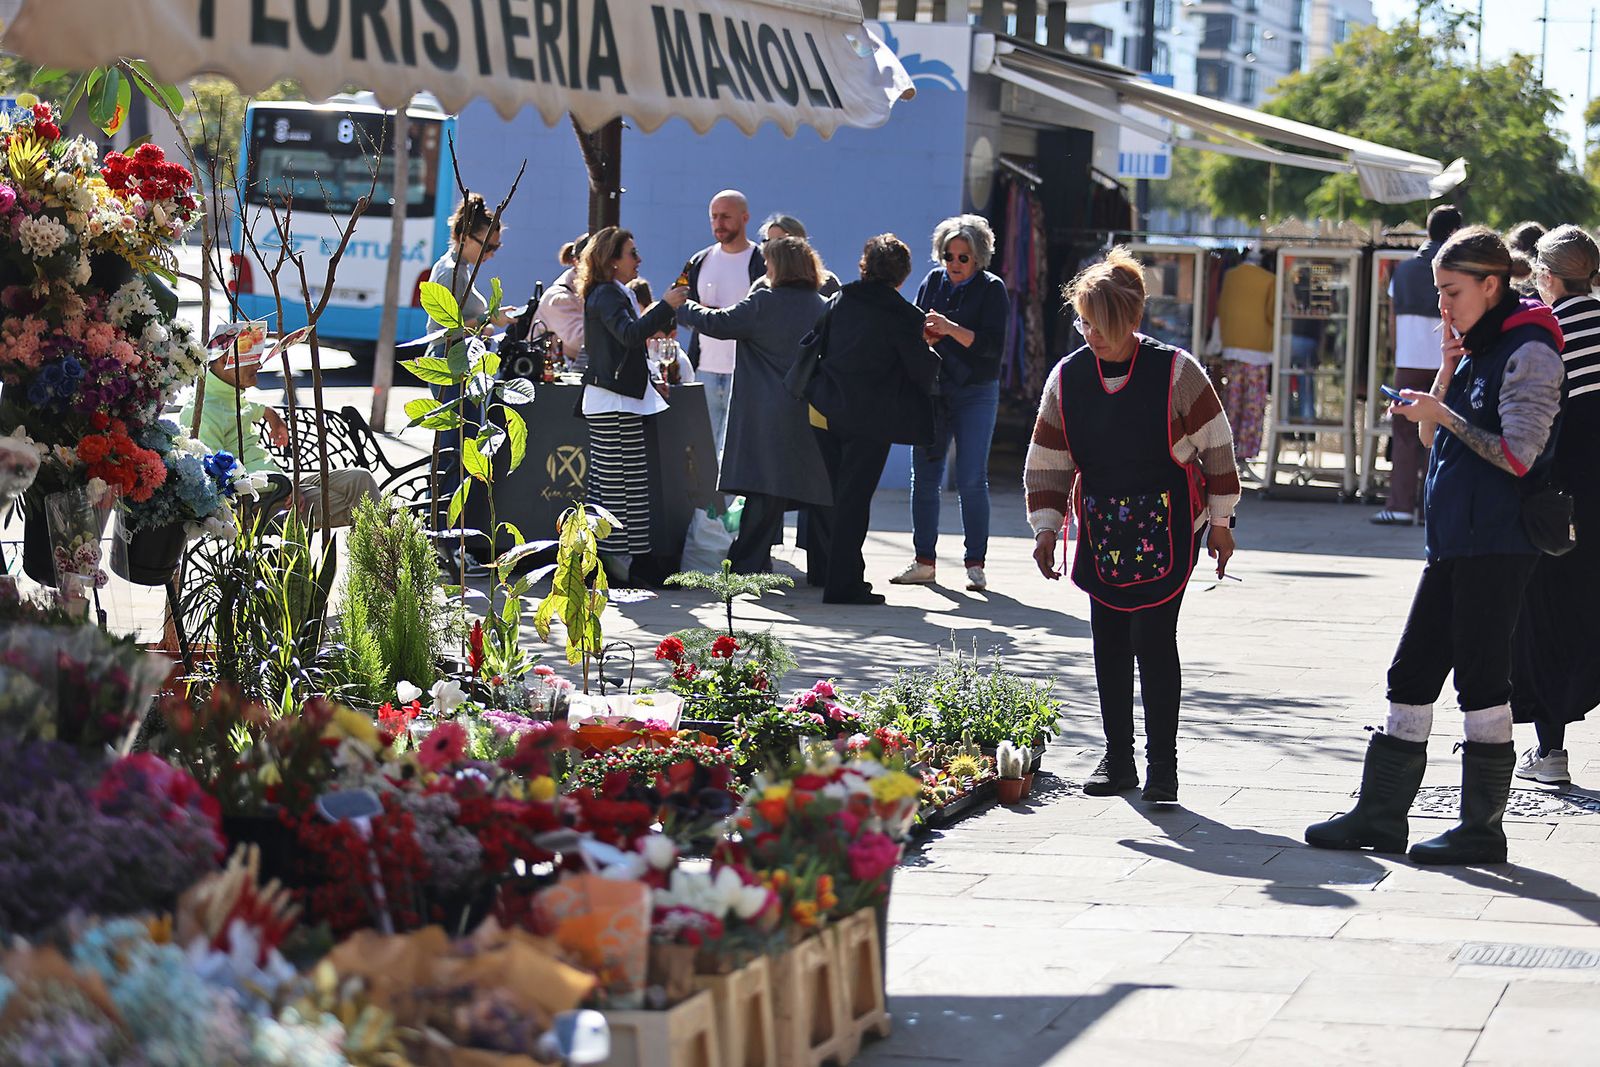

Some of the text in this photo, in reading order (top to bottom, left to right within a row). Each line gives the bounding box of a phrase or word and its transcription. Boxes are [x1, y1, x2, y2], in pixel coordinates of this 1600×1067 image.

[651, 5, 843, 109] MANOLI
[337, 118, 353, 144] 8
[319, 238, 425, 262] EMTUA
